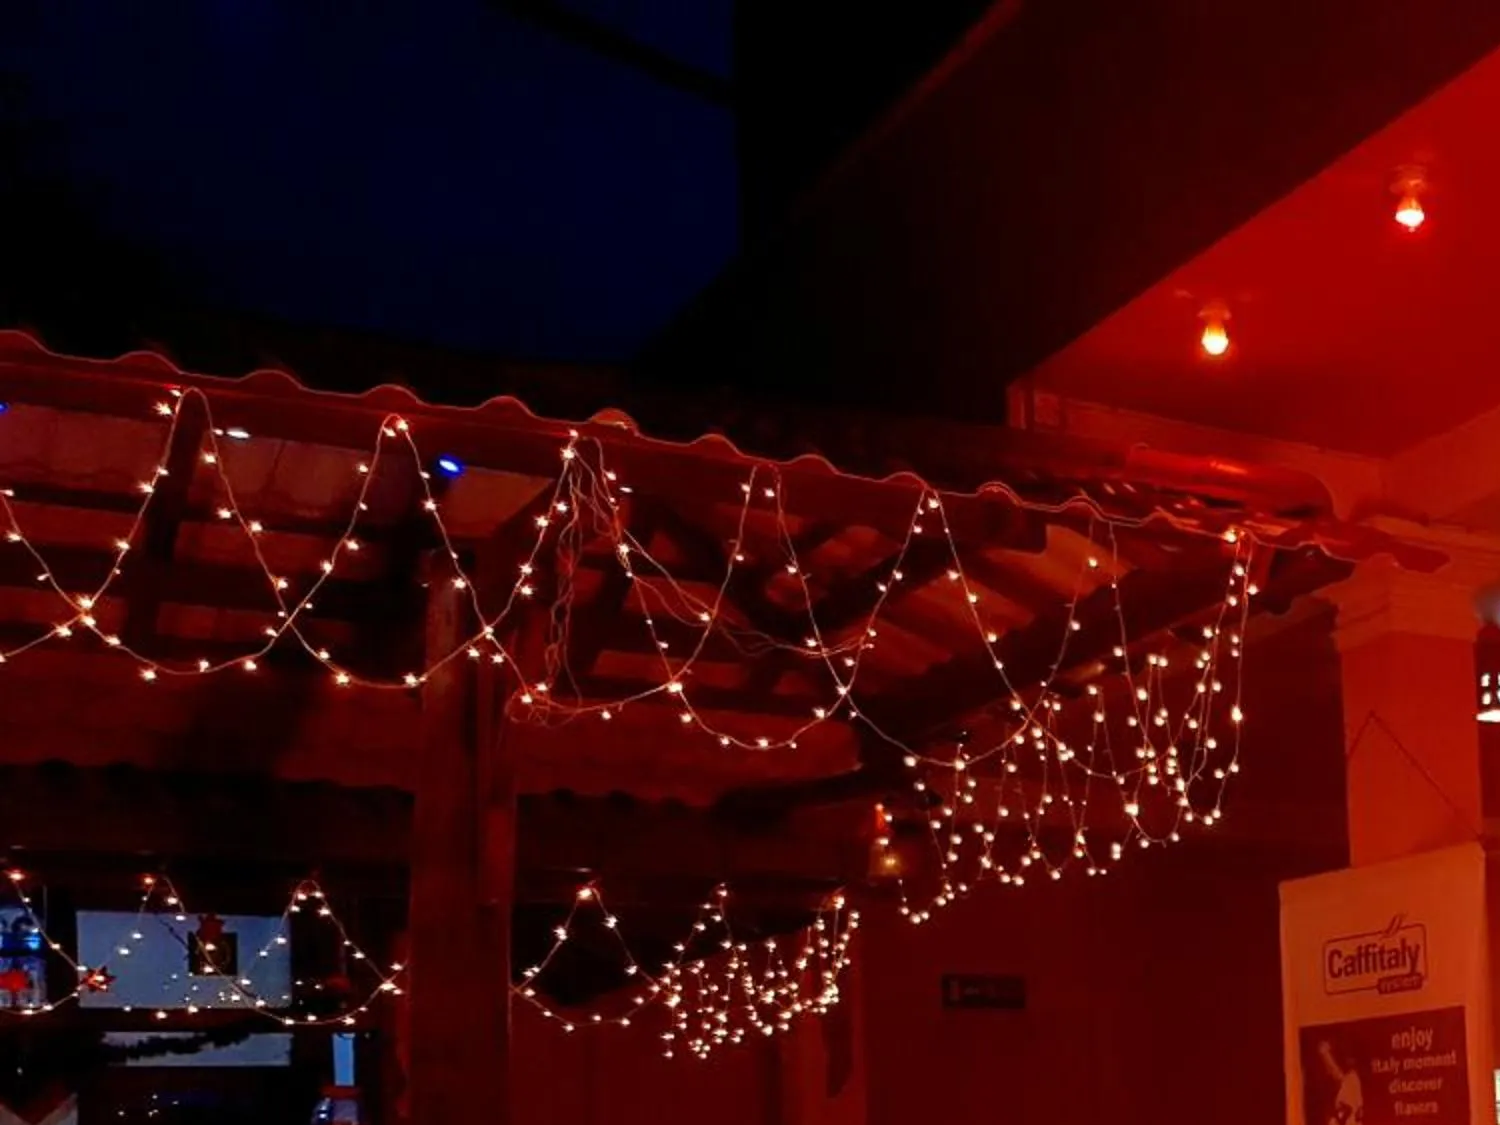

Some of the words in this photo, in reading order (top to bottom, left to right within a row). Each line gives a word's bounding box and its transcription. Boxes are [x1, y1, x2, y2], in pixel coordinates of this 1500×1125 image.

[1328, 938, 1420, 979] Caffitaly
[1391, 1026, 1433, 1052] enjoy
[1403, 1051, 1457, 1070] moment
[1389, 1077, 1443, 1094] discover
